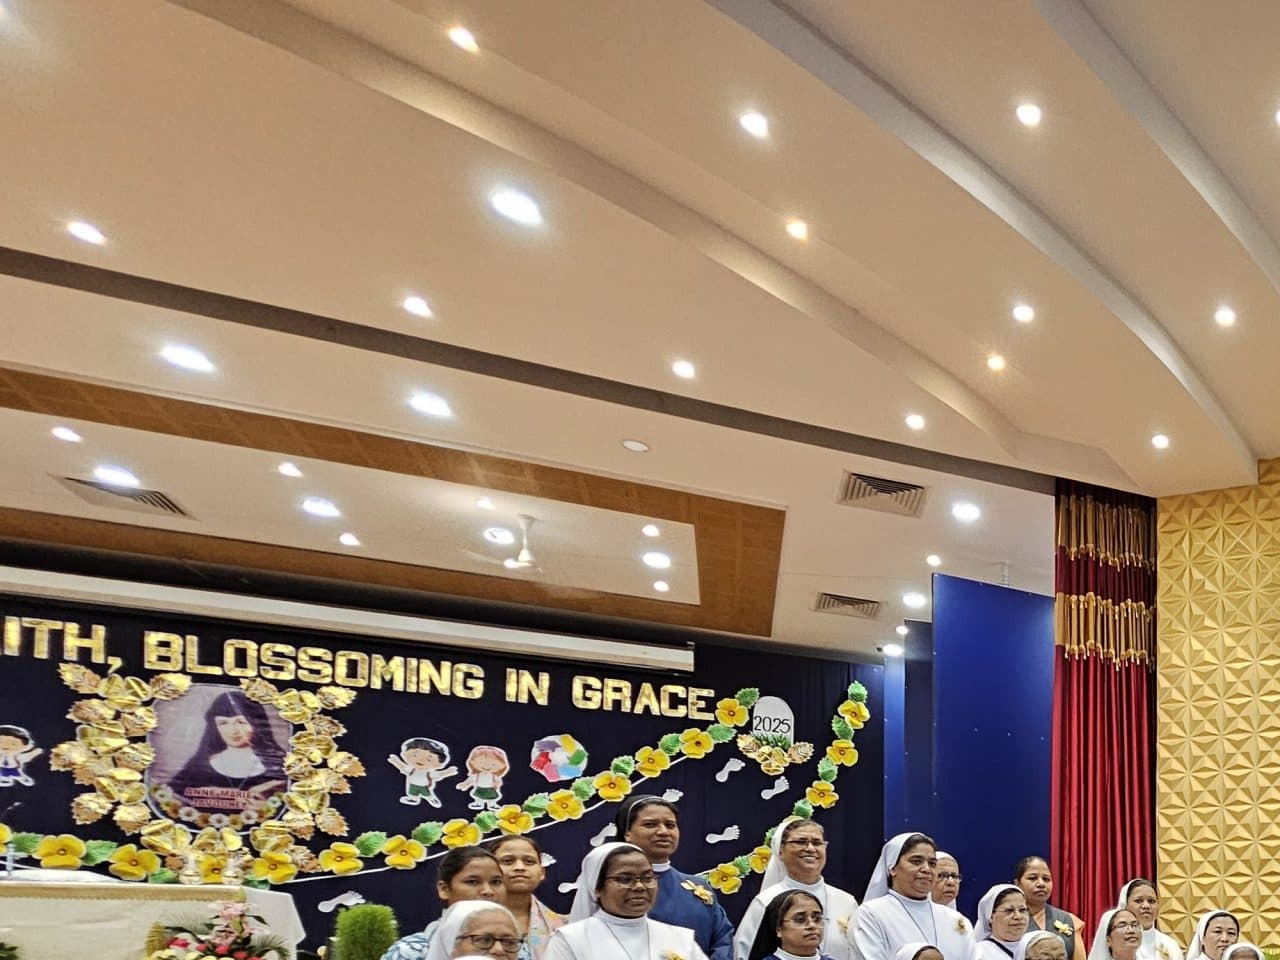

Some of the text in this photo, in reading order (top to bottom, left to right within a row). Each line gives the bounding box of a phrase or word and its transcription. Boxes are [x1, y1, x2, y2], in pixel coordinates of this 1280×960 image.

[3, 615, 715, 721] ITH, BLOSSOMING IN GRACE
[753, 715, 791, 733] 2025
